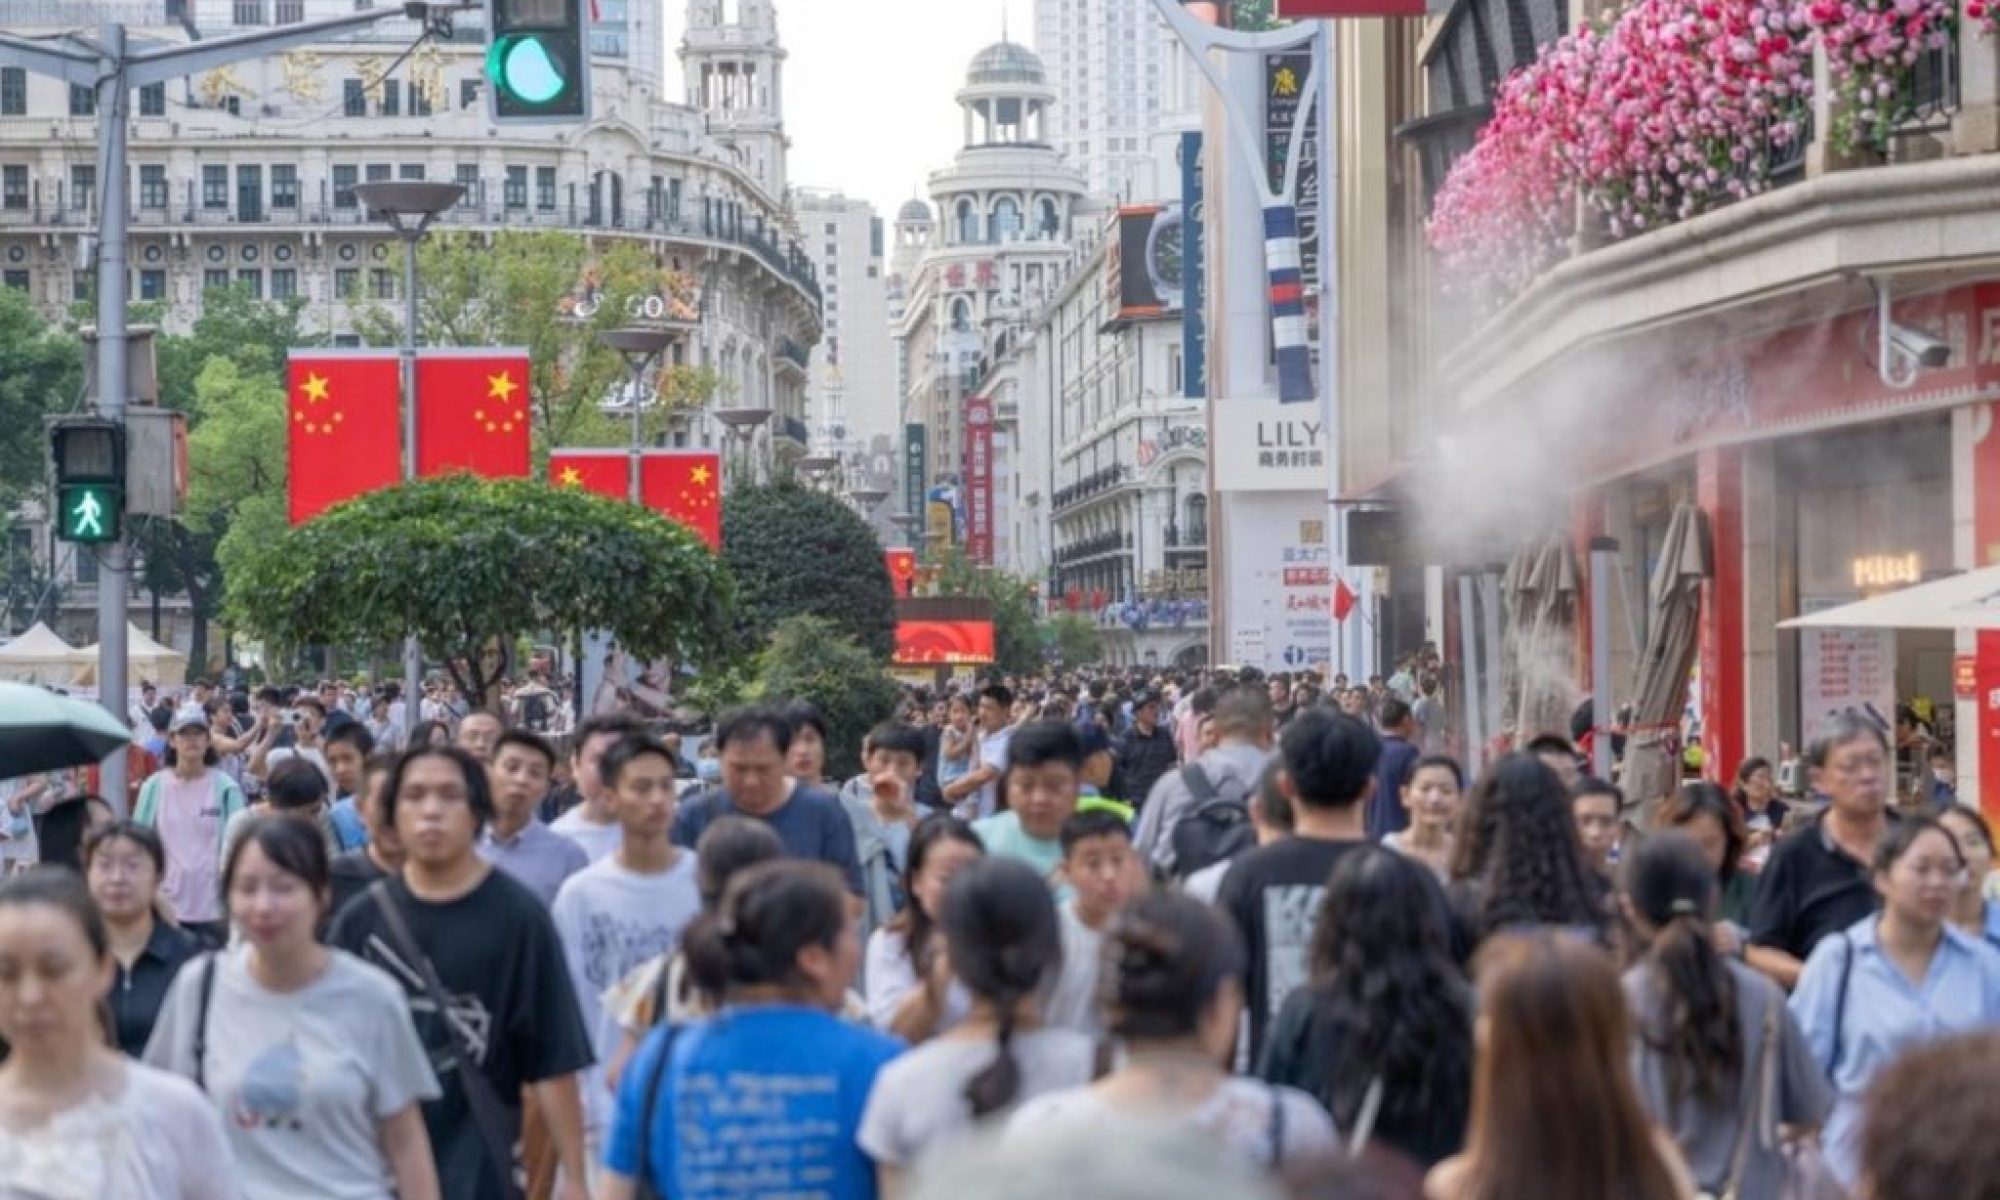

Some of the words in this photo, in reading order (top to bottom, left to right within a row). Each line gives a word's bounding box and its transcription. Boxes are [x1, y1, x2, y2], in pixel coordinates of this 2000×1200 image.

[1258, 421, 1321, 446] LILY
[1259, 450, 1323, 468] 商务时装
